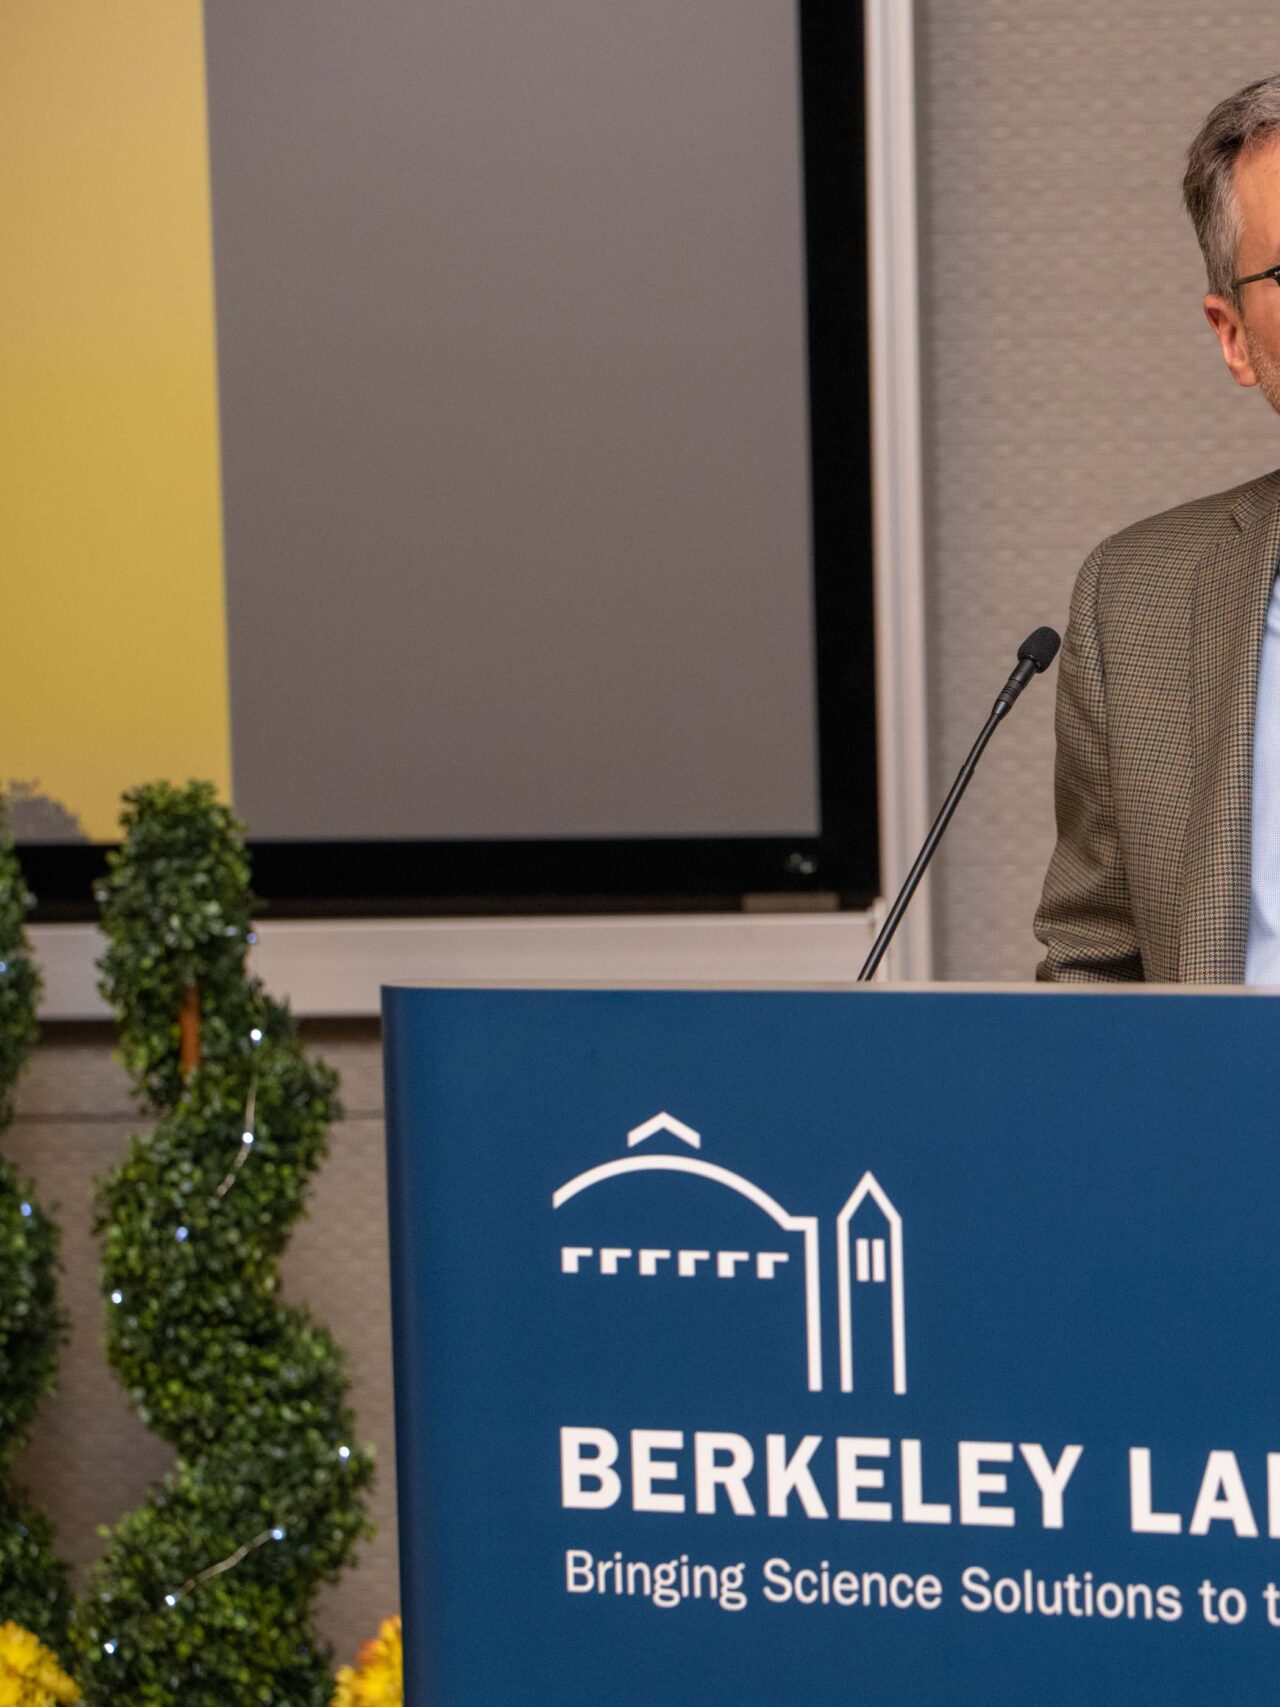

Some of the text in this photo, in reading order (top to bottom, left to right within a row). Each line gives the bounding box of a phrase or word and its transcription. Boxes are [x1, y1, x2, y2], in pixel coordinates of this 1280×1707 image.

[559, 1426, 1084, 1529] BERKELEY
[565, 1549, 748, 1612] Bringing
[762, 1557, 943, 1610] Science
[960, 1566, 1183, 1622] Solutions
[1197, 1579, 1248, 1625] to
